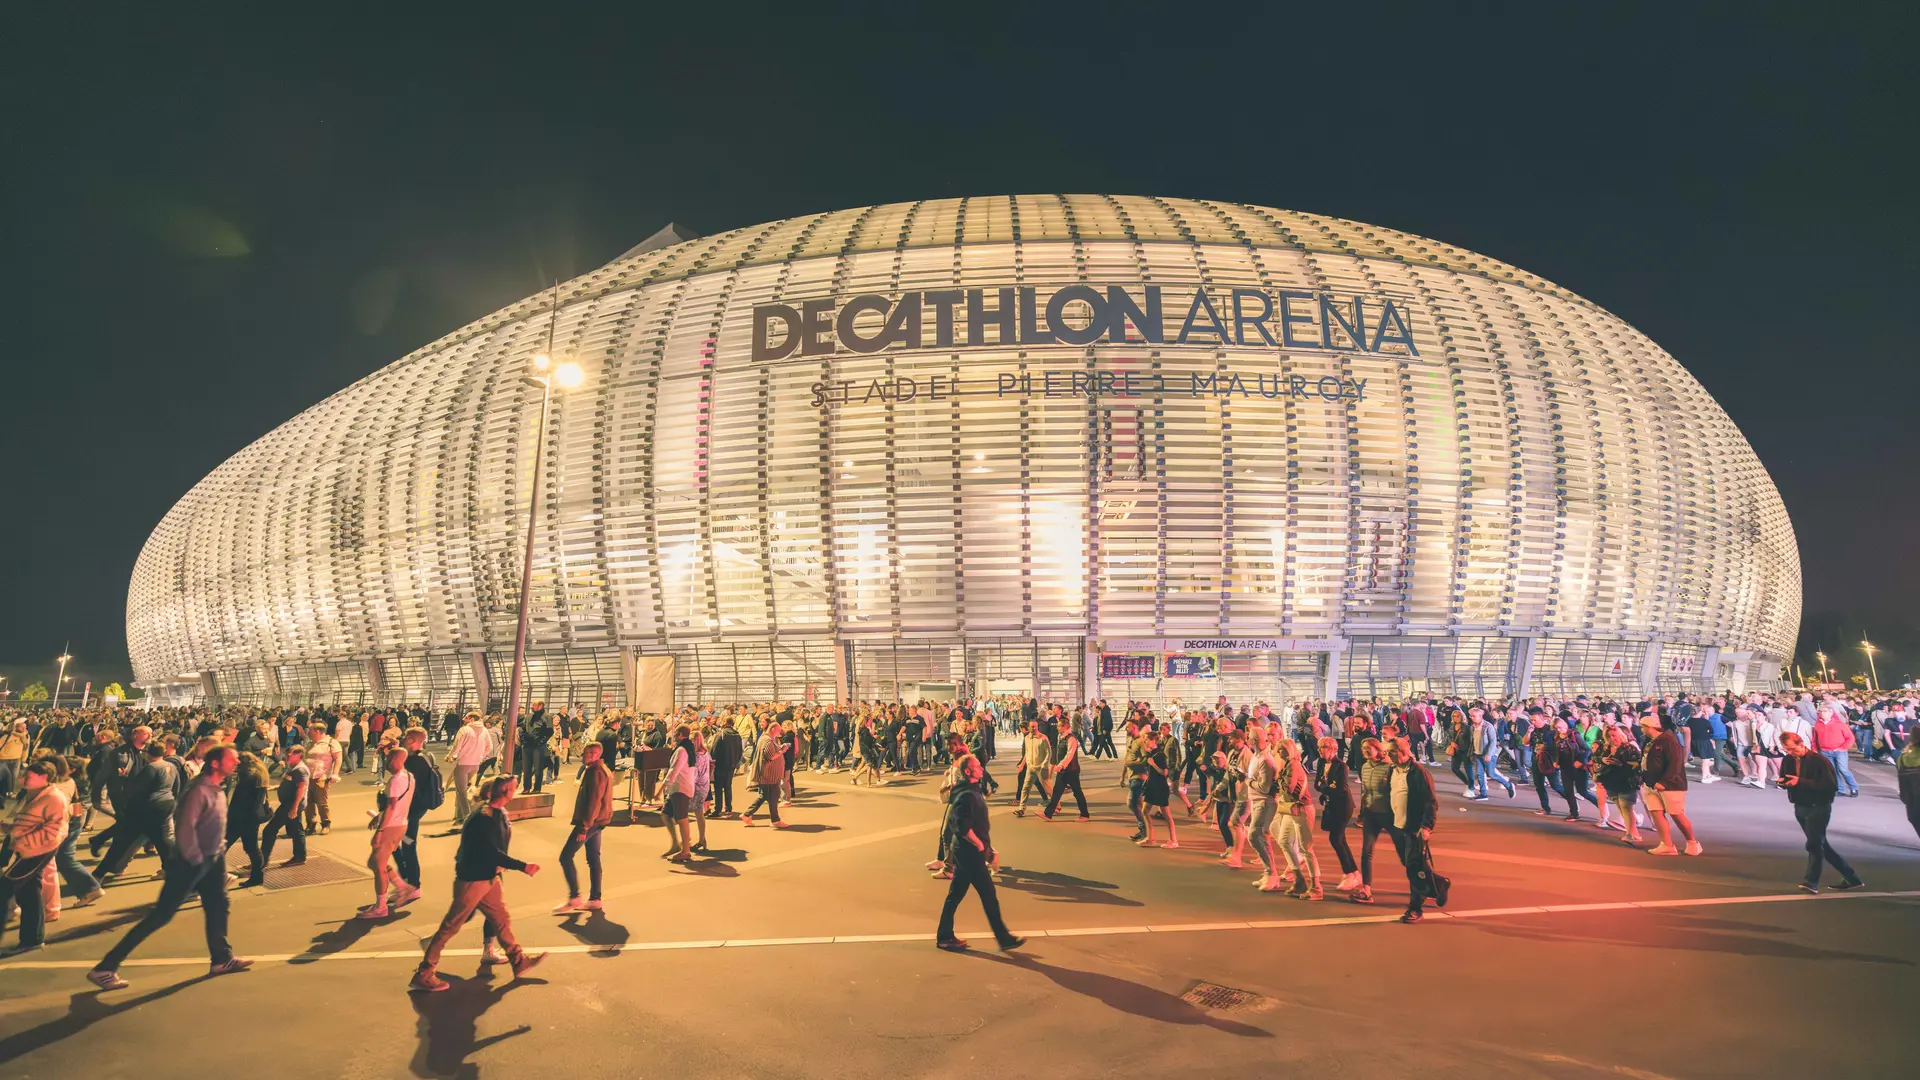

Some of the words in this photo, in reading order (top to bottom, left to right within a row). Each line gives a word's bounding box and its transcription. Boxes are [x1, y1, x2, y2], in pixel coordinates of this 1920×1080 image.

[752, 284, 1164, 362] DECATHLON
[1175, 285, 1420, 357] ARENA
[810, 375, 947, 408] STADE
[998, 371, 1142, 400] PIERRE
[1191, 371, 1368, 403] MAUROY
[1184, 640, 1237, 649] DECATHLON
[1239, 640, 1278, 649] ARENA
